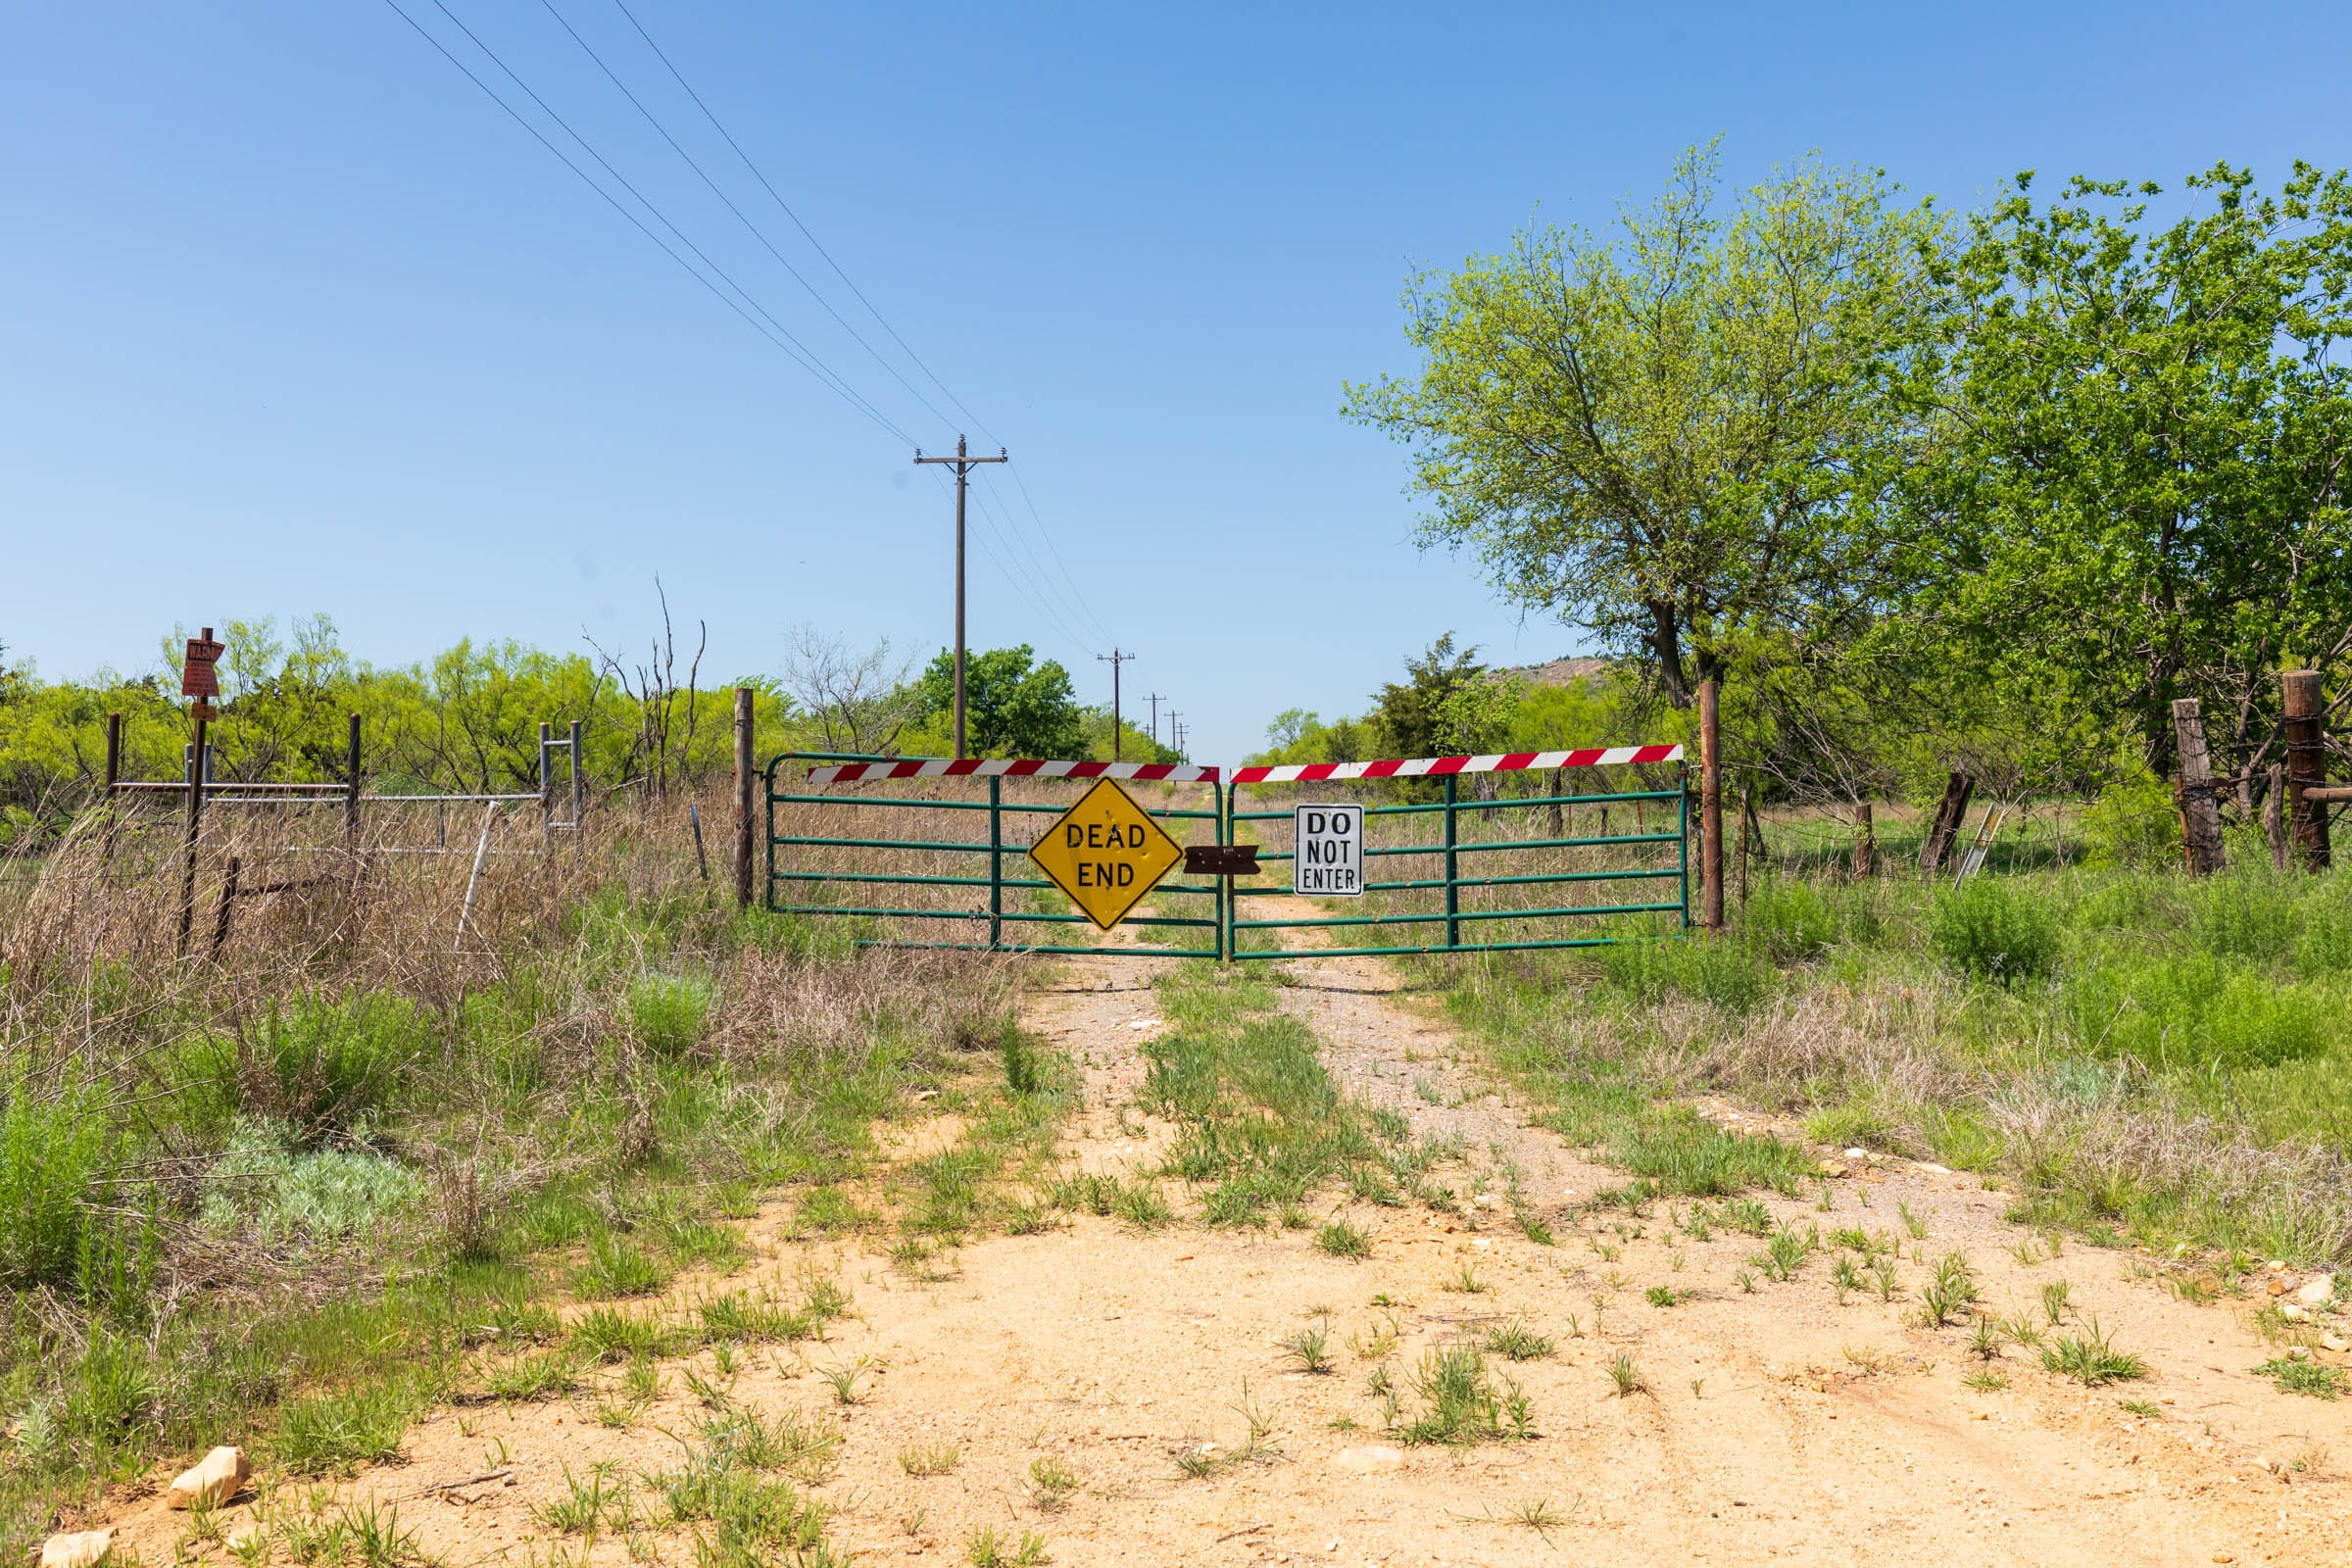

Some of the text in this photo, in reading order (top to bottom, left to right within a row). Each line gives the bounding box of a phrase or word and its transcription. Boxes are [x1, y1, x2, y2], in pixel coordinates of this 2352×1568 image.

[1307, 812, 1351, 835] DO
[1067, 824, 1146, 849] DEAD
[1307, 840, 1351, 864] NOT
[1078, 862, 1134, 887] END
[1303, 868, 1354, 889] ENTER
